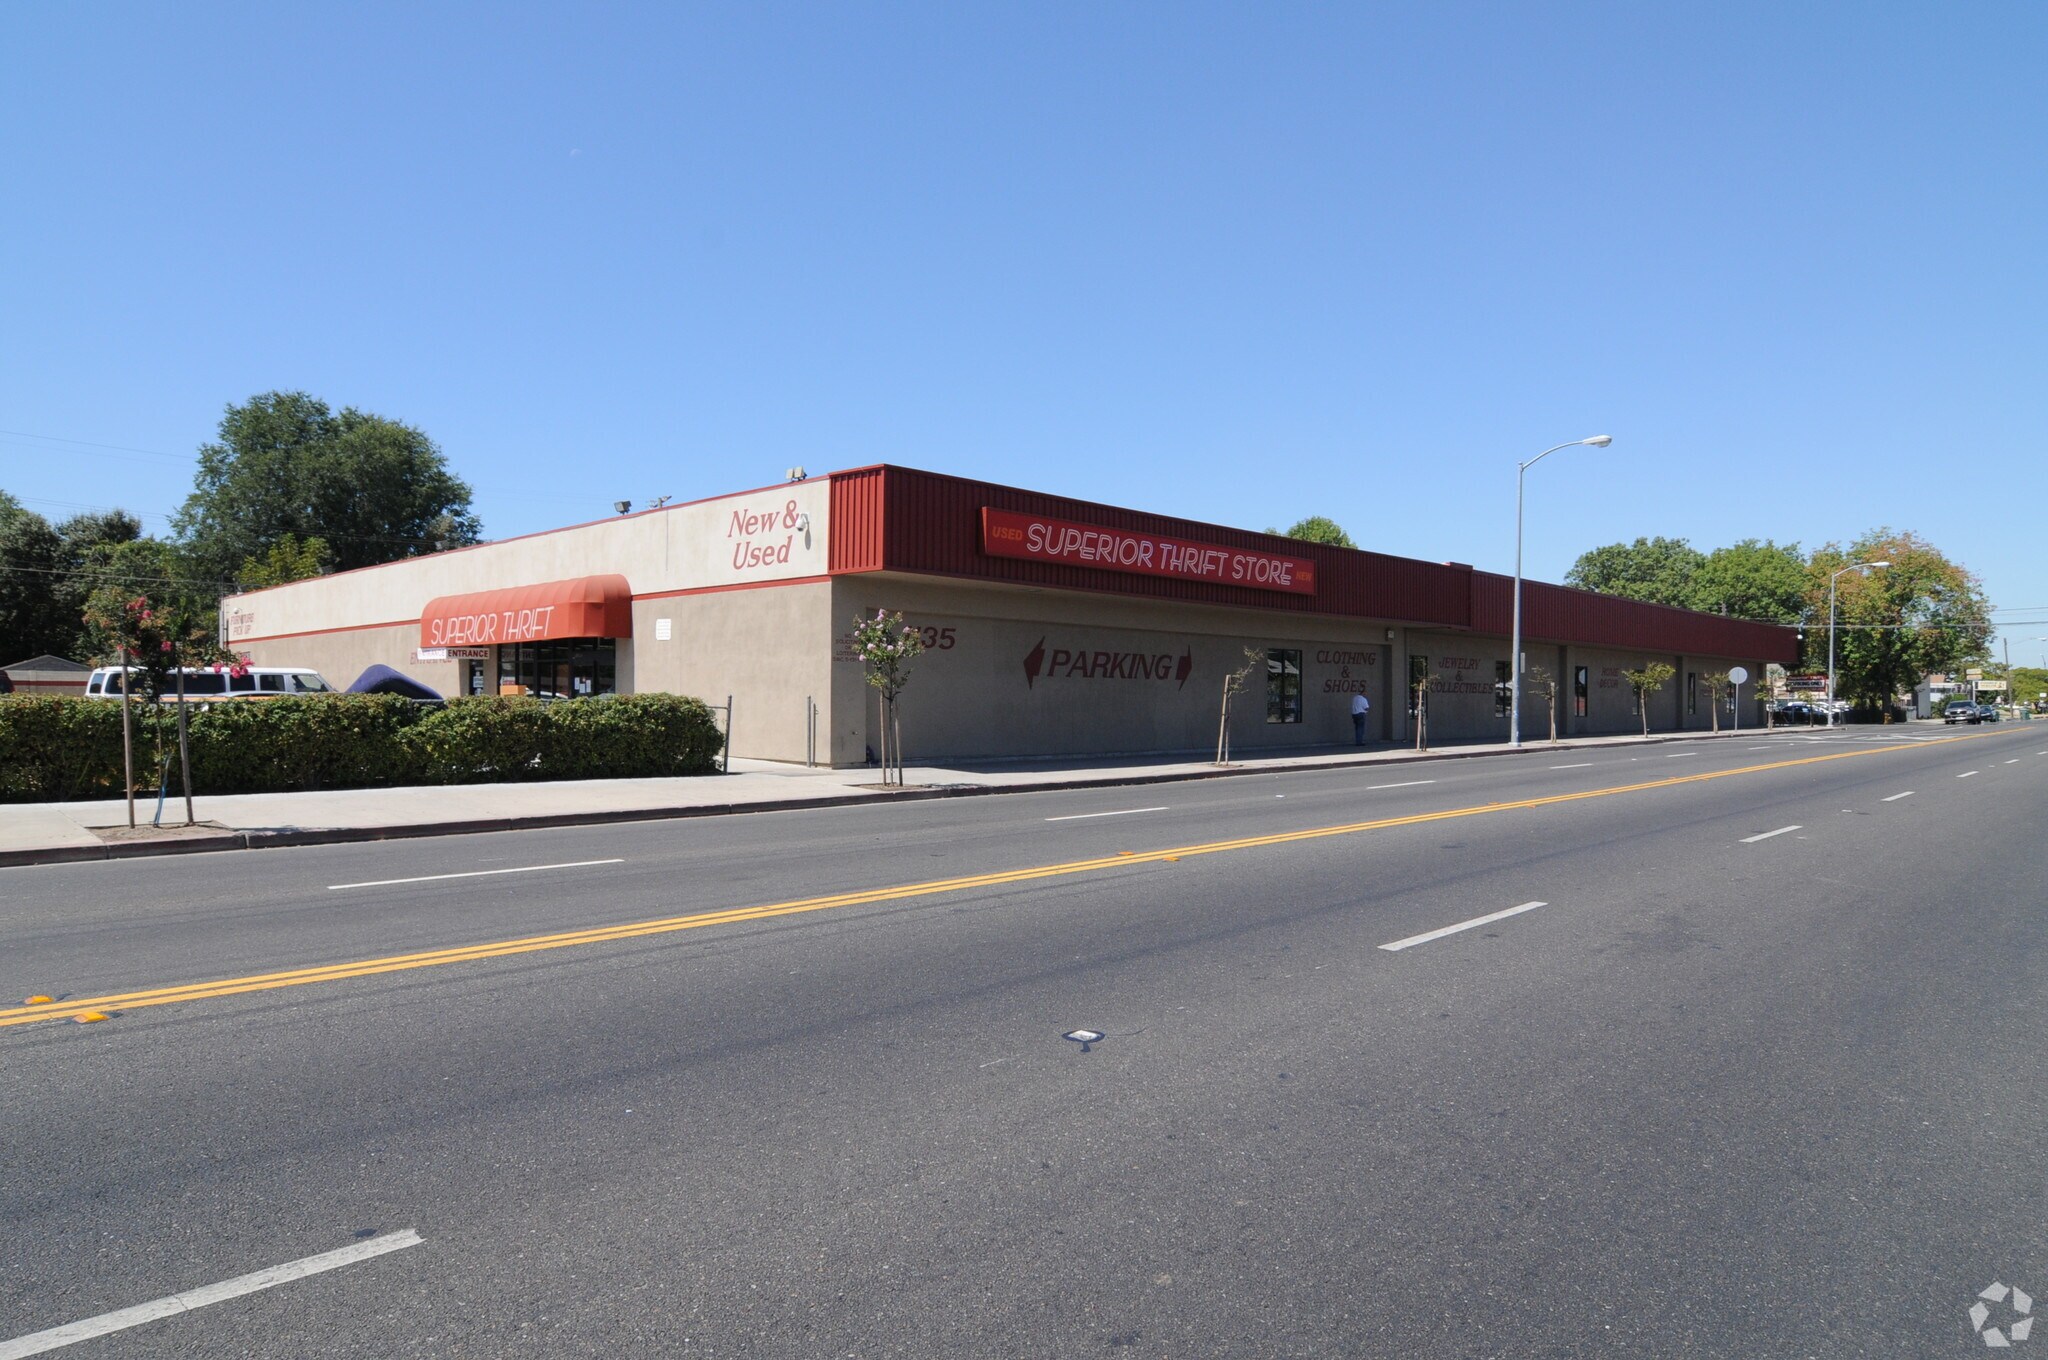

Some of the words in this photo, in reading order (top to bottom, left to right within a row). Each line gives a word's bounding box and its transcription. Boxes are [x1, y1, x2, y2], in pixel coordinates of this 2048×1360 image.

[727, 509, 780, 538] New
[783, 500, 800, 529] &
[733, 535, 793, 570] Used
[992, 526, 1023, 542] USED
[1026, 523, 1154, 568] SUPERIOR
[1159, 543, 1229, 577] THRIFT
[1232, 555, 1293, 586] STORE
[430, 613, 497, 645] SUPERIOR
[502, 606, 555, 641] THRIFT
[448, 649, 489, 658] ENTRANCE
[1317, 650, 1376, 665] CLOTHING
[1047, 649, 1173, 680] PARKING
[1439, 657, 1481, 670] JEWELRY
[1341, 666, 1351, 678] &
[1455, 671, 1464, 682] &
[1601, 667, 1619, 676] HOME
[1323, 679, 1367, 694] SHOES
[1430, 682, 1494, 694] COLLECTIBLES
[1599, 679, 1618, 688] DECOR
